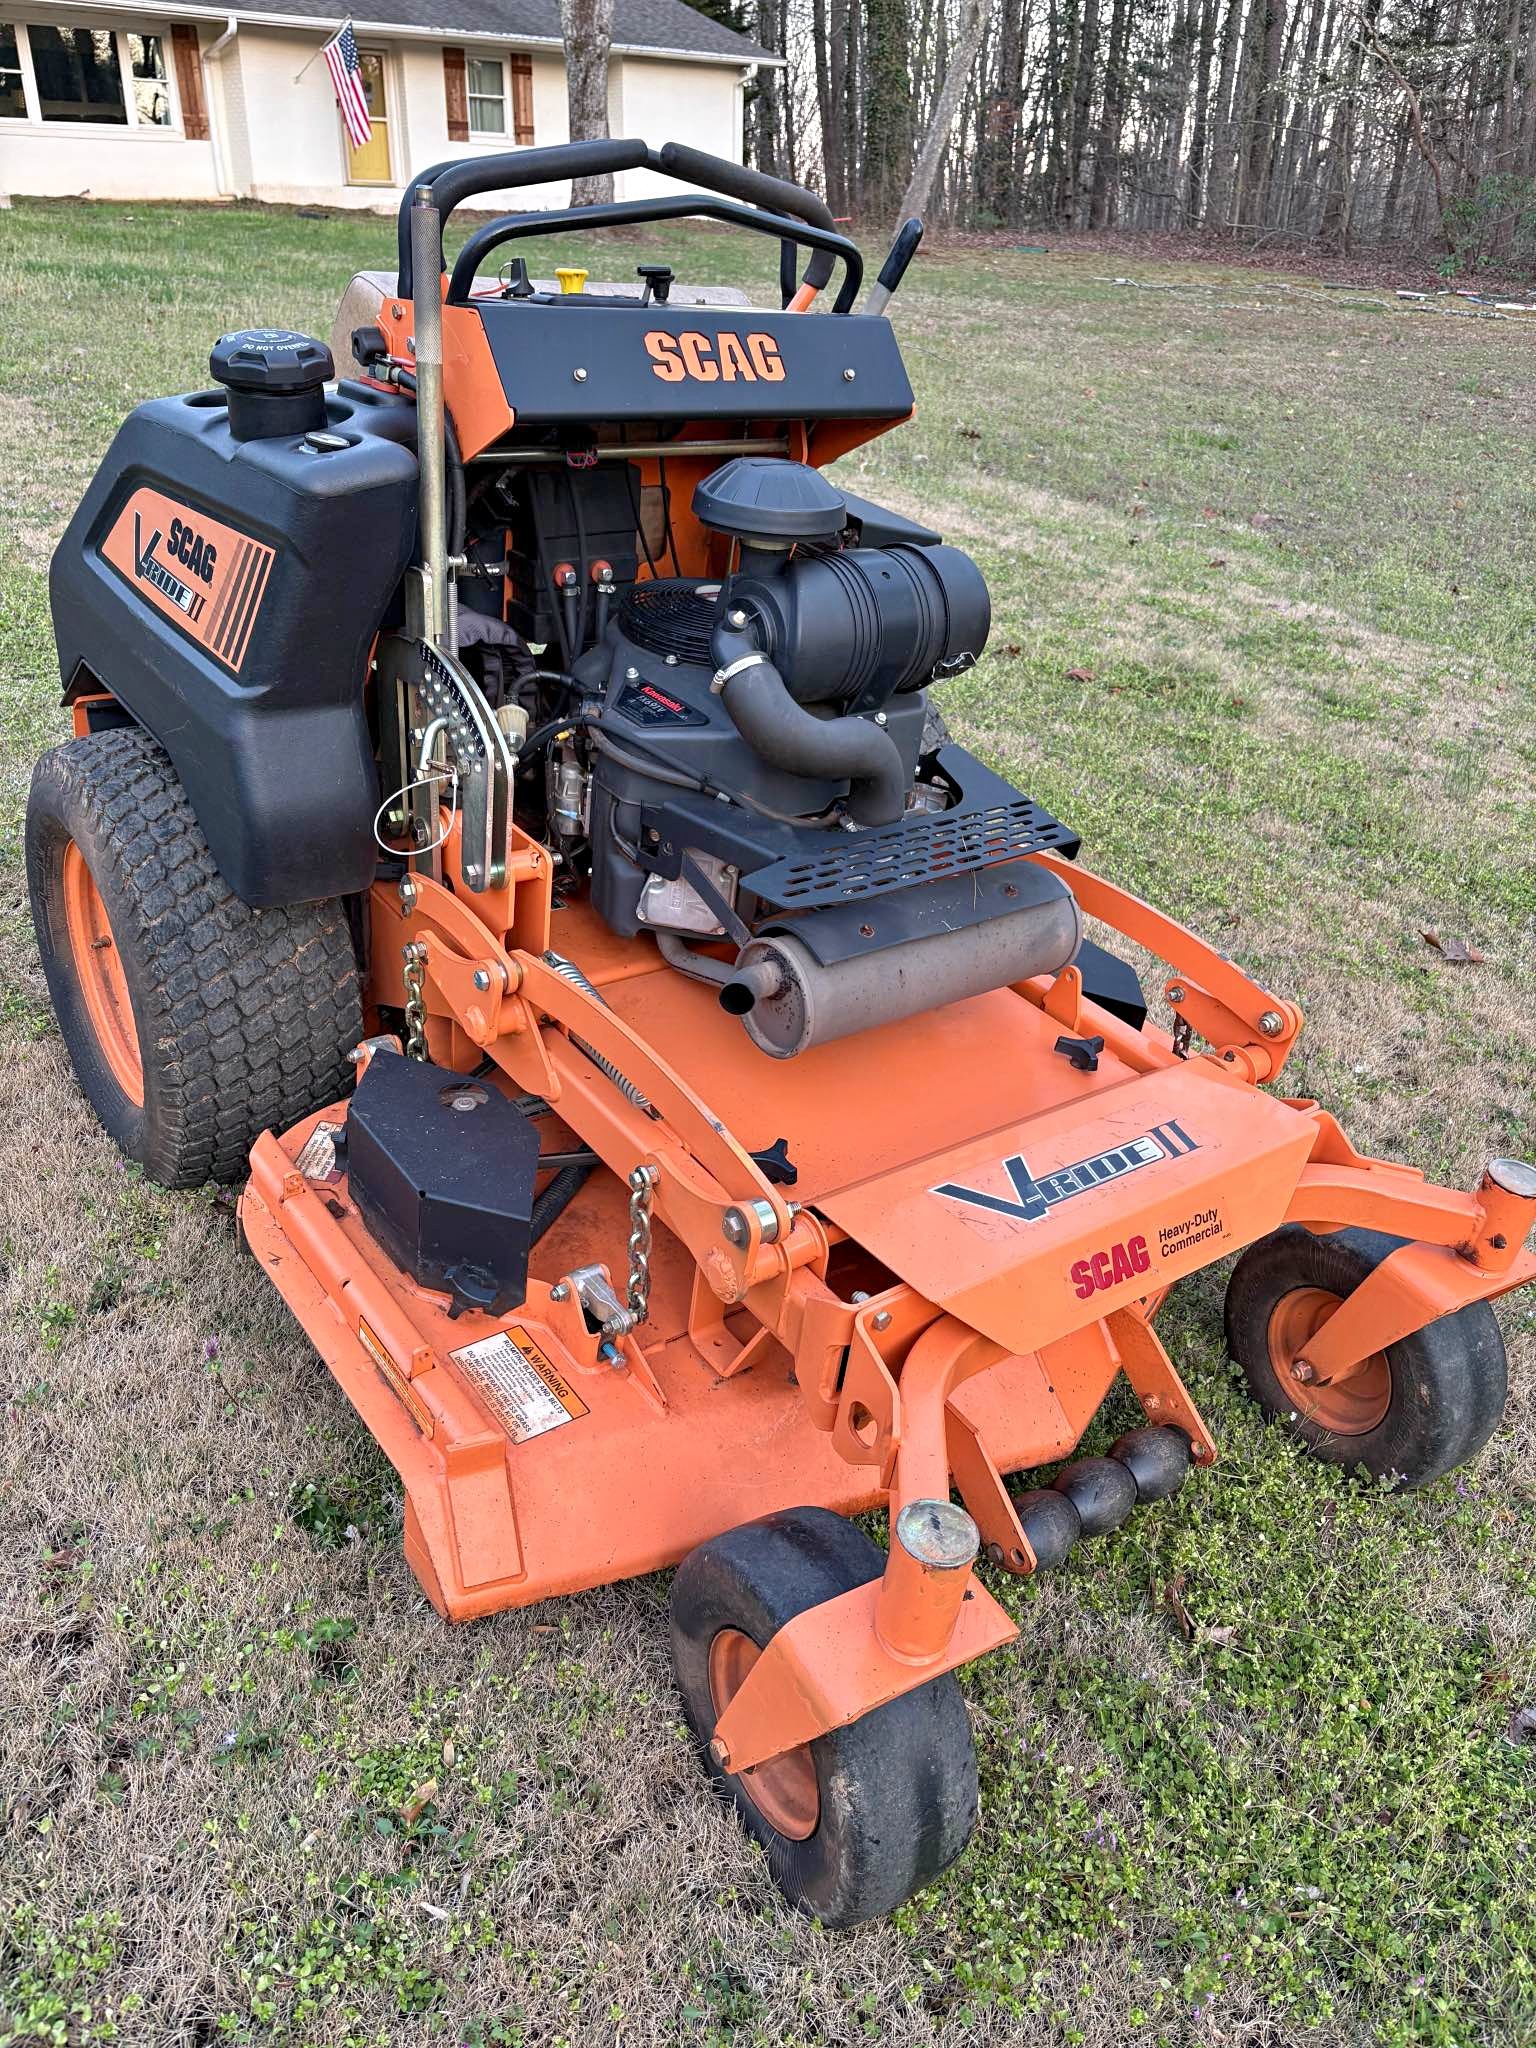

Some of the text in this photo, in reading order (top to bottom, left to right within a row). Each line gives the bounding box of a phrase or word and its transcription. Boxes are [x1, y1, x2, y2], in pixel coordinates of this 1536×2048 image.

[644, 331, 786, 381] SCAG
[166, 517, 217, 584] SCAG
[641, 686, 686, 712] Kawasaki
[929, 1119, 1203, 1223] V-RIDE II
[1158, 1208, 1218, 1243] Heavy-Duty
[1161, 1219, 1223, 1258] Commercial
[1070, 1235, 1151, 1300] SCAG
[466, 1350, 476, 1358] DO
[472, 1358, 484, 1369] NOT
[481, 1370, 502, 1393] OPERATE
[499, 1393, 517, 1413] UNLESS
[515, 1413, 531, 1432] GRASS
[502, 1339, 525, 1364] ROTATING
[522, 1364, 541, 1384] BLADES
[538, 1385, 550, 1396] AND
[547, 1396, 564, 1414] BELTS
[528, 1354, 569, 1398] WARNING
[504, 1410, 514, 1419] KIT
[511, 1420, 520, 1428] OR
